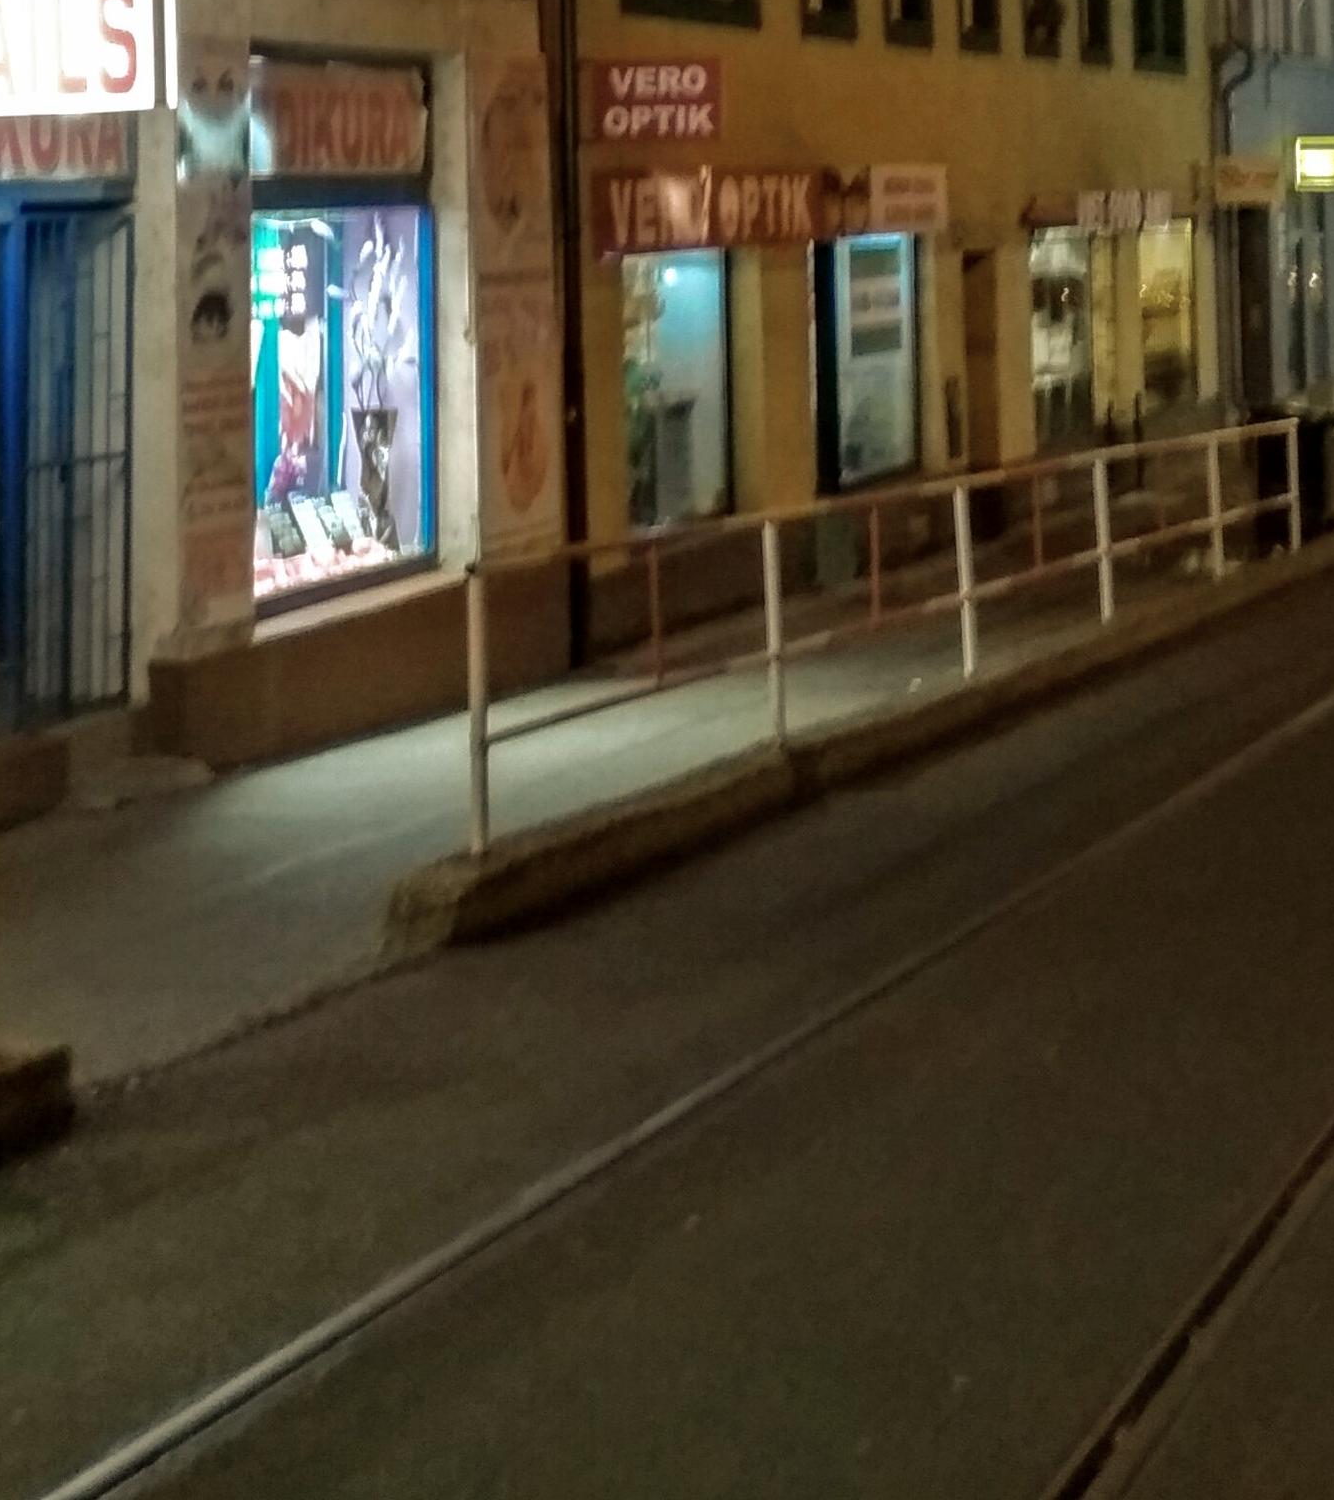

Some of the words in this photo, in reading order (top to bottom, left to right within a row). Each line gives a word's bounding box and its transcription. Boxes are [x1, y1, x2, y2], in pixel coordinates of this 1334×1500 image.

[609, 63, 709, 101] VERO
[602, 102, 716, 140] OPTIK
[719, 174, 814, 242] OPTIK
